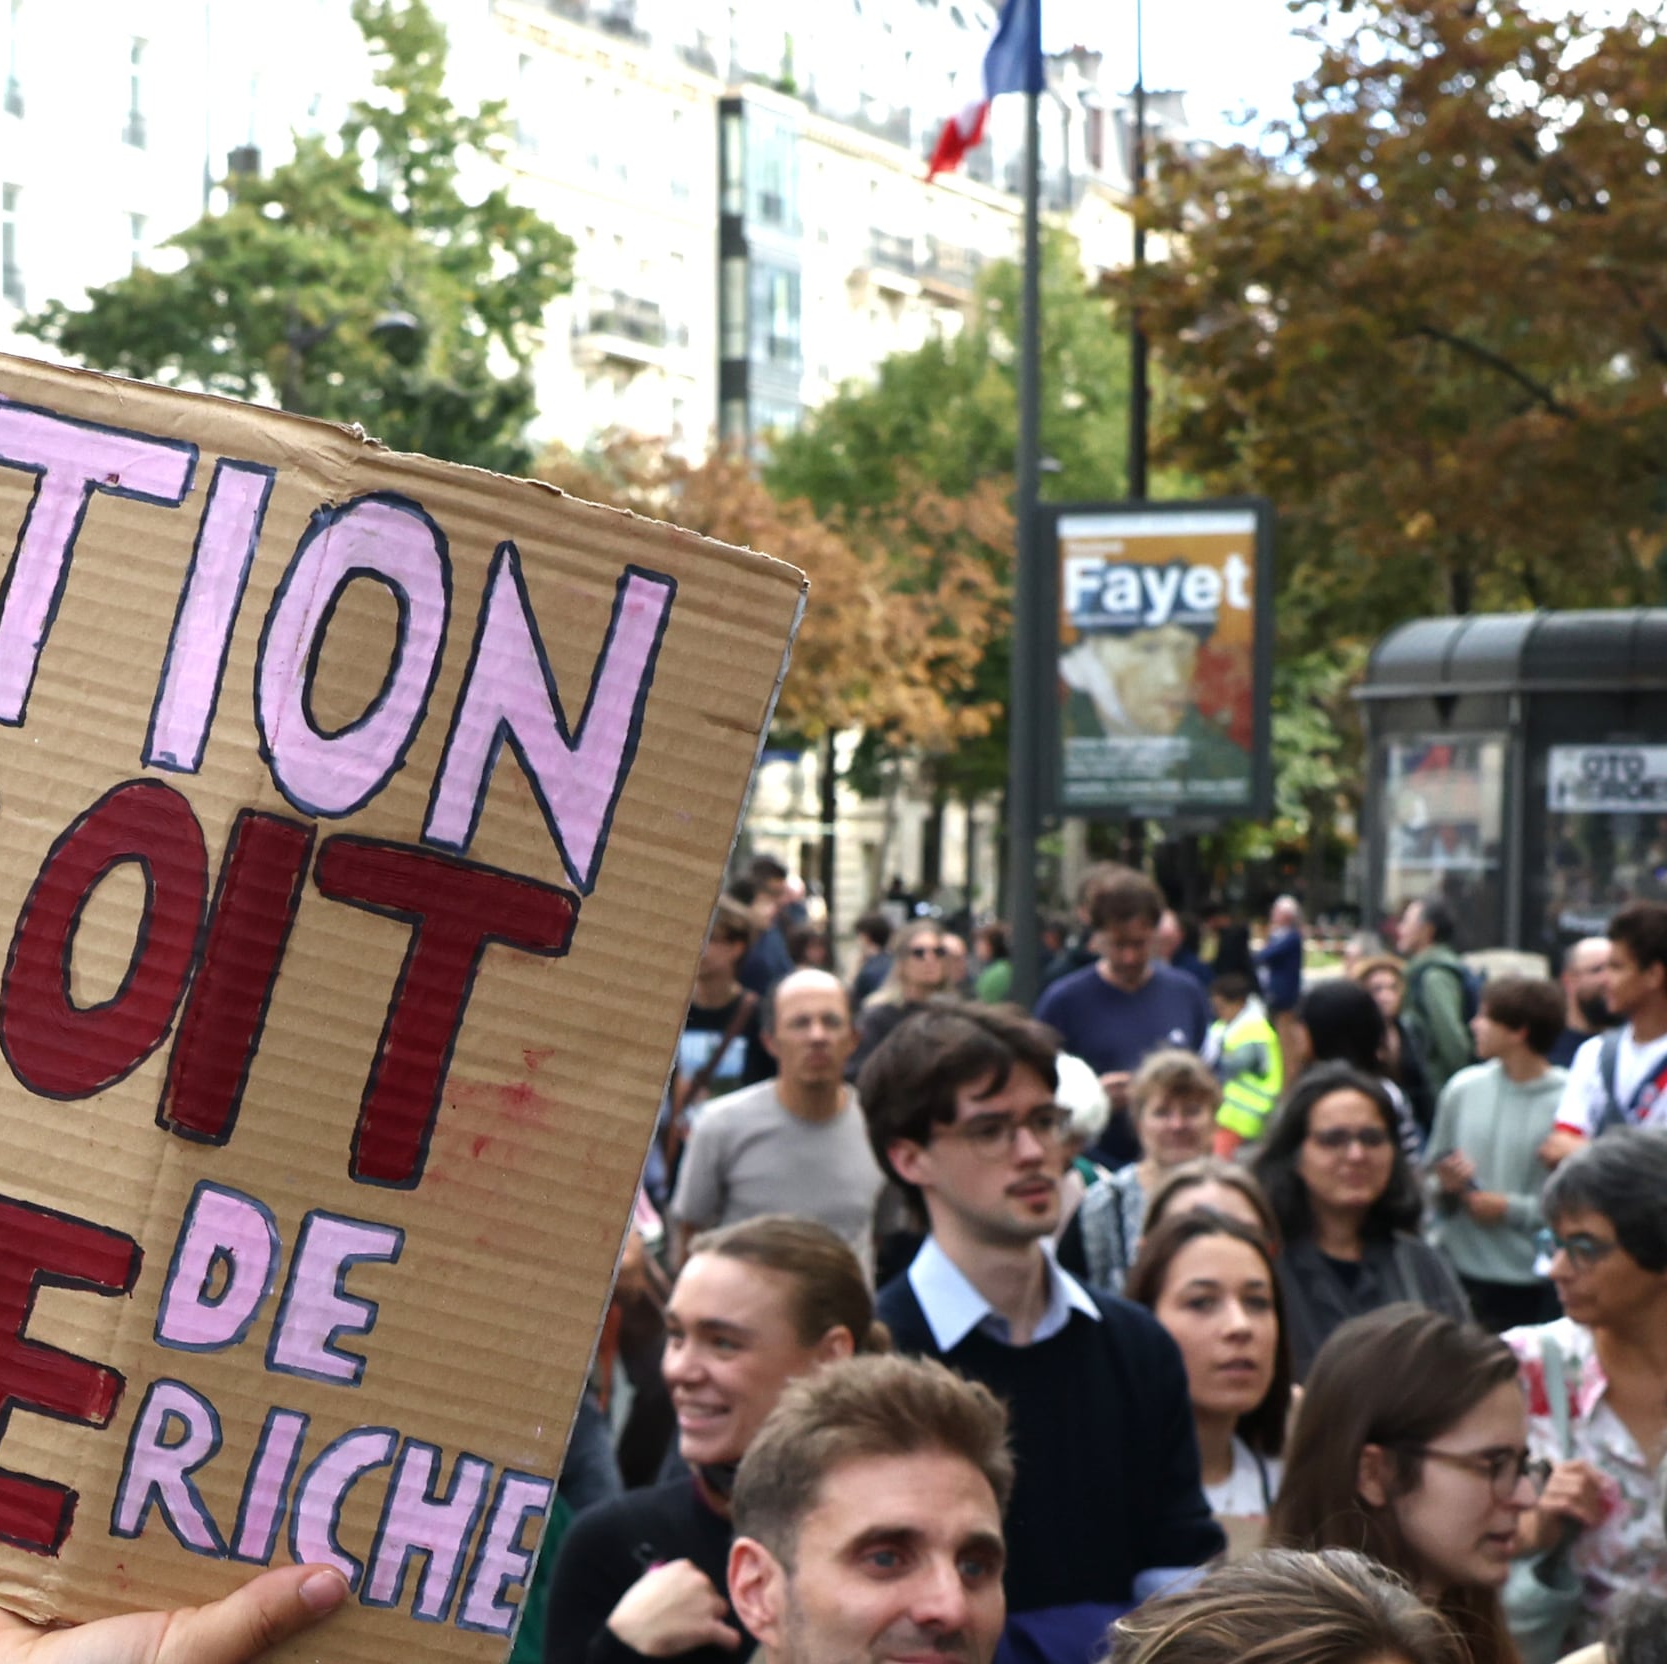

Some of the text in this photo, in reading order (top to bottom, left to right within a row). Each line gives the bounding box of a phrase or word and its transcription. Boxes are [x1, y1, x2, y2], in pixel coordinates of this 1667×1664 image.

[1063, 552, 1251, 626] Fayet
[152, 1178, 405, 1388] DE
[108, 1376, 555, 1636] RICHE
